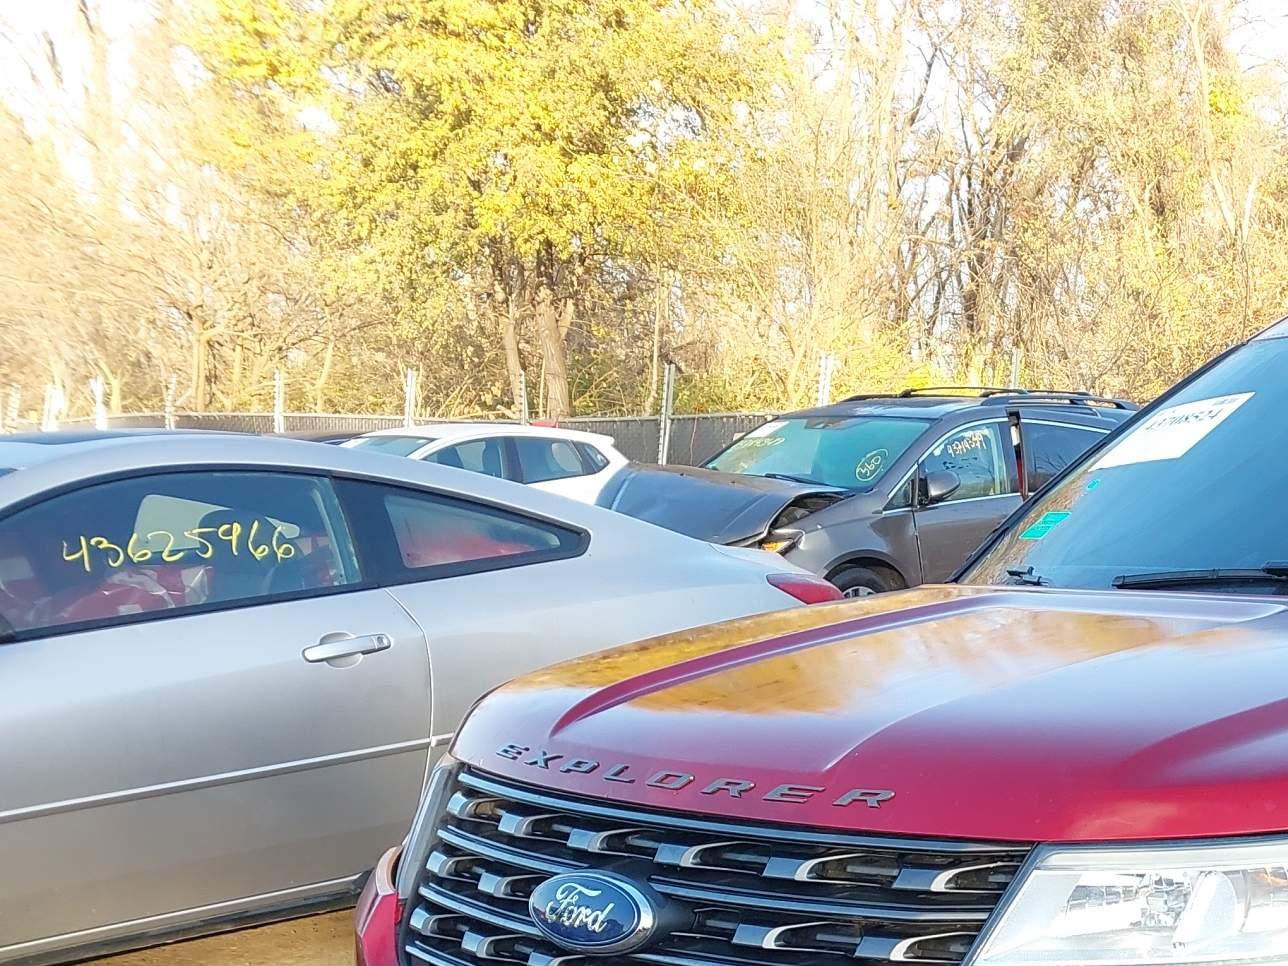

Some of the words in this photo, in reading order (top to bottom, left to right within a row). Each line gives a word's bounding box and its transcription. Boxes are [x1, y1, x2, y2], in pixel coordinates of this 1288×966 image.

[856, 454, 882, 477] 360
[62, 520, 295, 572] 43625966
[496, 743, 896, 809] EXPLORER
[545, 882, 614, 934] Ford
